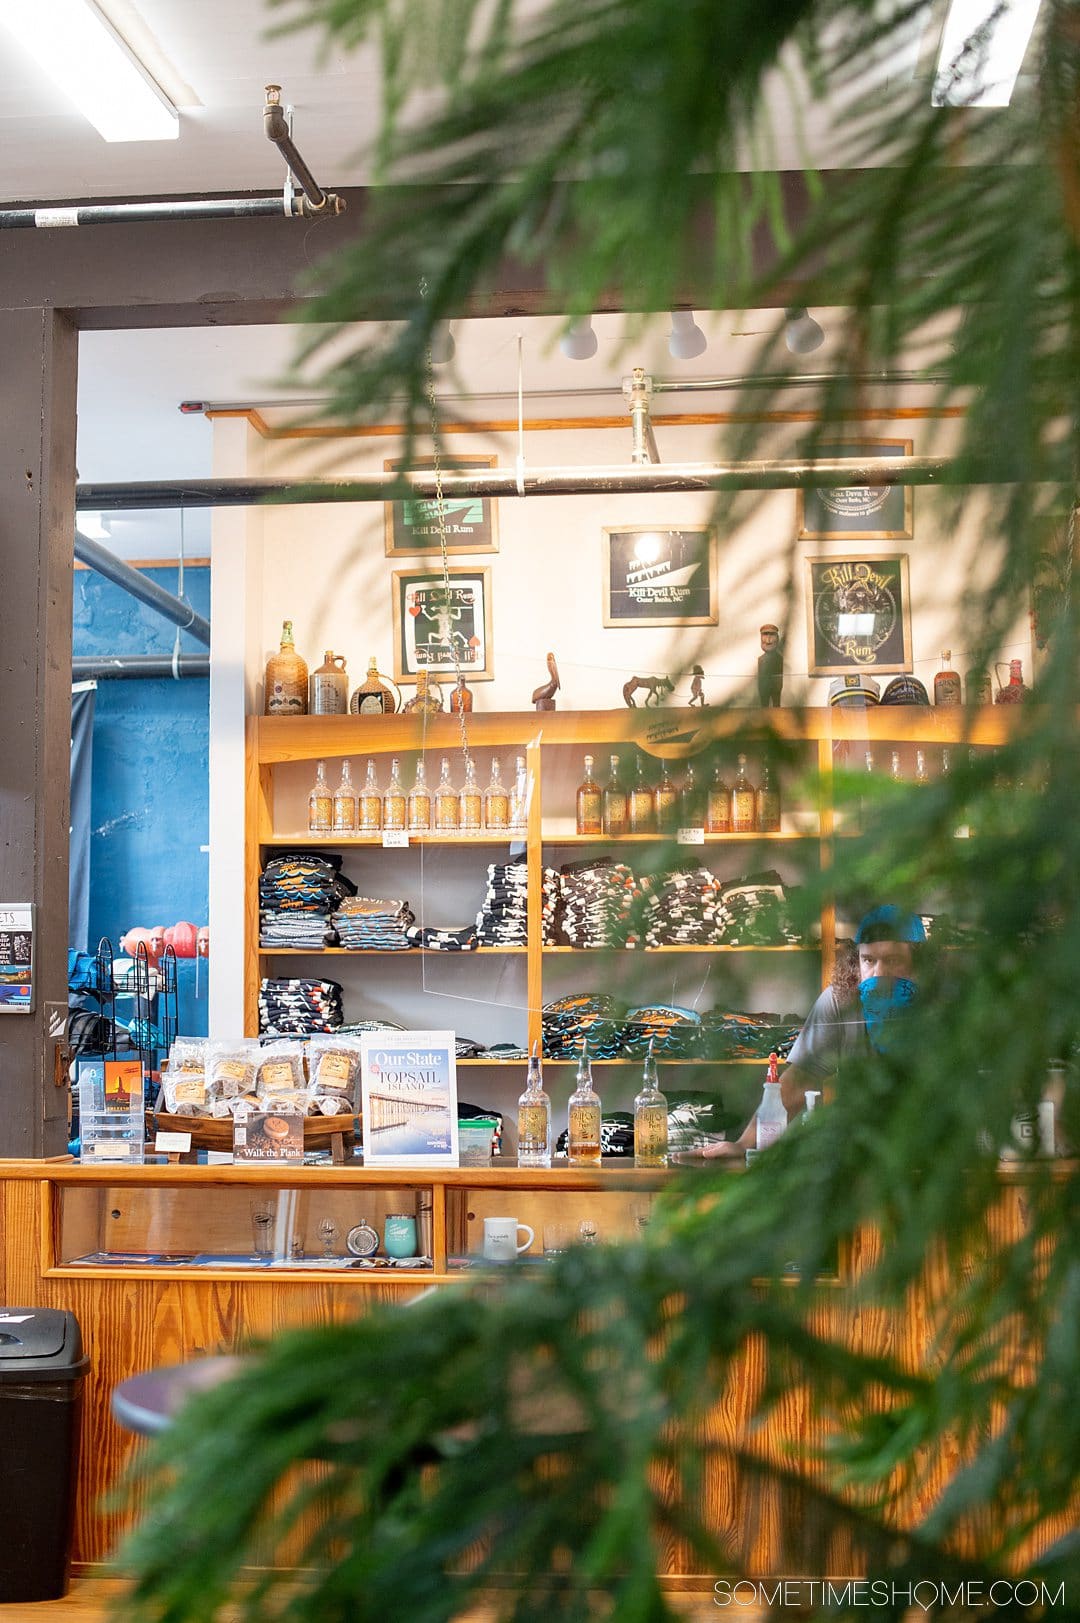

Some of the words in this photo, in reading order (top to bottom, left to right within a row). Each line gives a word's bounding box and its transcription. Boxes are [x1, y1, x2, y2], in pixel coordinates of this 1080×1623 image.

[412, 525, 429, 535] Kill
[430, 525, 452, 535] Deil
[452, 524, 474, 534] Rum
[822, 563, 853, 589] Kill
[853, 563, 895, 590] Devil
[628, 587, 646, 597] Kill
[647, 586, 668, 597] Devil
[670, 586, 691, 597] Rum
[844, 640, 877, 664] Rum
[375, 1052, 405, 1066] Our
[407, 1052, 442, 1066] State
[379, 1071, 441, 1084] TOPSAIL
[388, 1083, 425, 1091] ISLAND
[243, 1148, 265, 1157] Walk
[266, 1148, 278, 1157] the
[280, 1148, 302, 1157] Plank
